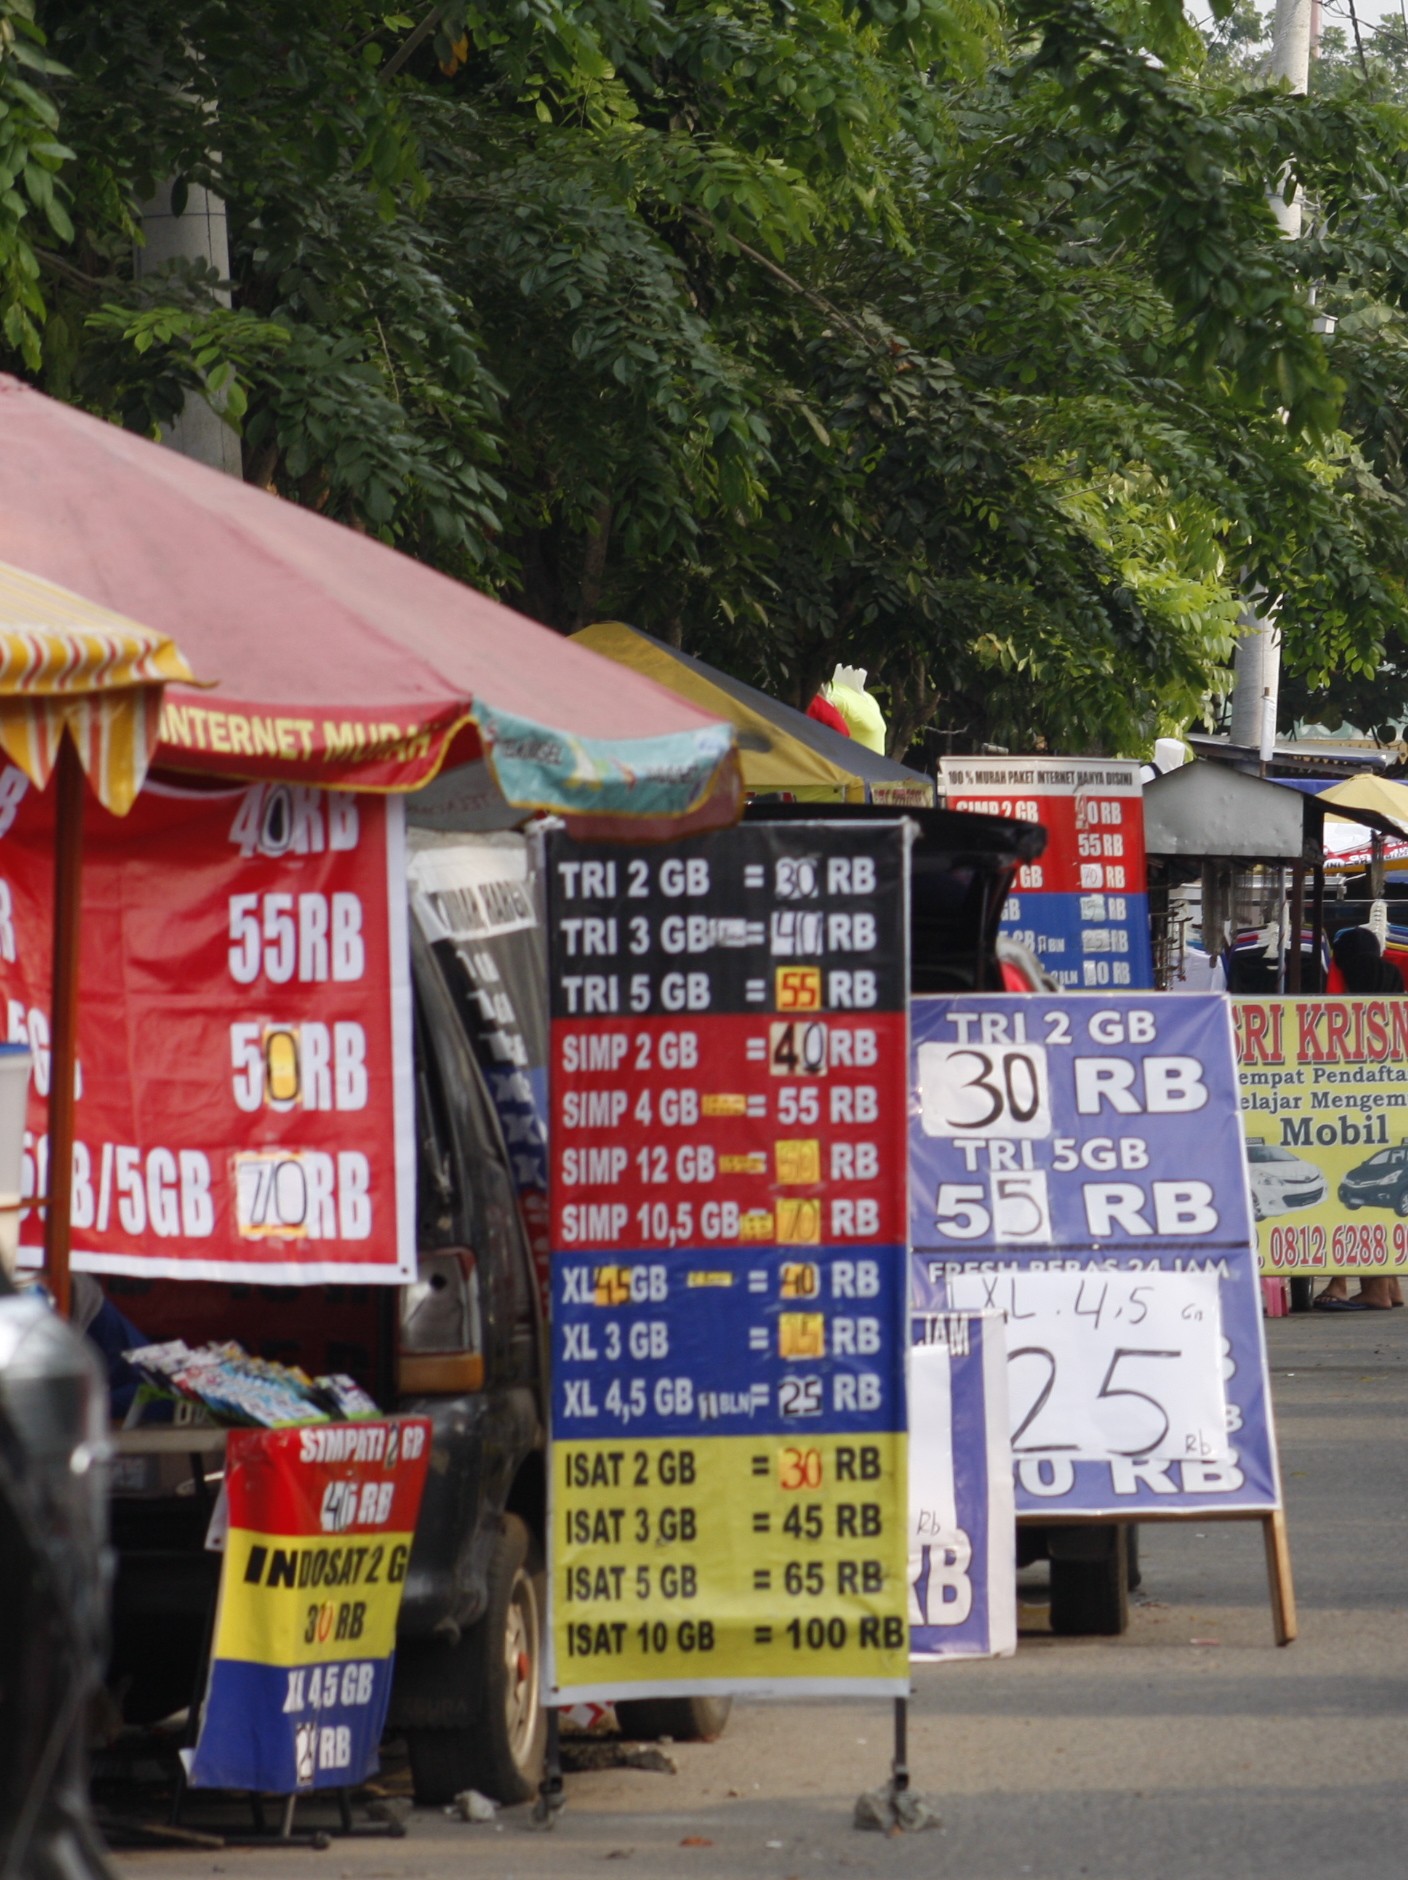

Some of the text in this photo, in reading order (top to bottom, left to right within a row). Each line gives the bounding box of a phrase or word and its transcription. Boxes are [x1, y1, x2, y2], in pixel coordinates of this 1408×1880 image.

[158, 703, 432, 763] INTERNET MURAH
[976, 772, 1006, 785] MURAH
[1008, 771, 1034, 784] PAKET
[1037, 771, 1075, 785] INTERNET
[1077, 771, 1104, 786] HANYA
[1106, 772, 1132, 786] DISINI
[1015, 801, 1039, 822] GB
[1102, 802, 1121, 824] RB
[1079, 834, 1123, 856] 55 RB
[559, 857, 876, 899] TRI GB RB
[1020, 866, 1125, 888] GB RB
[1108, 898, 1126, 920] RB
[228, 893, 364, 983] 55RB
[561, 914, 876, 955] TRI RB
[562, 971, 877, 1013] TRI GB 55 RB
[946, 1010, 1157, 1044] TRI GB
[231, 1022, 367, 1112] 50RB
[562, 1023, 878, 1074] SIMP GB 40 RB
[562, 1090, 628, 1128] SIMP
[659, 1089, 698, 1126] GB
[778, 1087, 819, 1124] 55
[831, 1086, 879, 1123] RB
[945, 1050, 1208, 1129] 30 RB
[1280, 1114, 1390, 1146] Mobil
[562, 1147, 628, 1185] SIMP
[637, 1146, 668, 1183] 12
[676, 1145, 715, 1183] GB
[831, 1143, 879, 1180] RB
[953, 1137, 1150, 1172] TRI 5GB
[562, 1204, 628, 1242] SIMP
[637, 1203, 693, 1248] 10,5
[832, 1199, 879, 1236] RB
[934, 1178, 1219, 1240] 55 RB
[1270, 1226, 1326, 1268] 0812
[1332, 1224, 1386, 1267] 6288
[630, 1265, 668, 1302] GB
[832, 1260, 879, 1297] RB
[562, 1317, 880, 1361] XL RB
[563, 1379, 598, 1417] XL
[605, 1377, 646, 1424] 4,5
[779, 1379, 822, 1416] 25
[1007, 1347, 1181, 1456] 25
[300, 1428, 386, 1463] SIMPATI
[566, 1447, 881, 1490] ISAT GB 30 RB
[357, 1482, 394, 1524] RB
[566, 1504, 823, 1545] ISAT 45
[244, 1545, 368, 1589] INDOSAT
[566, 1560, 884, 1602] ISAT GB 65 RB
[335, 1602, 366, 1641] RB
[567, 1616, 905, 1658] ISAT 10 GB 100 RB
[341, 1663, 375, 1705] GB
[320, 1726, 351, 1770] RB
